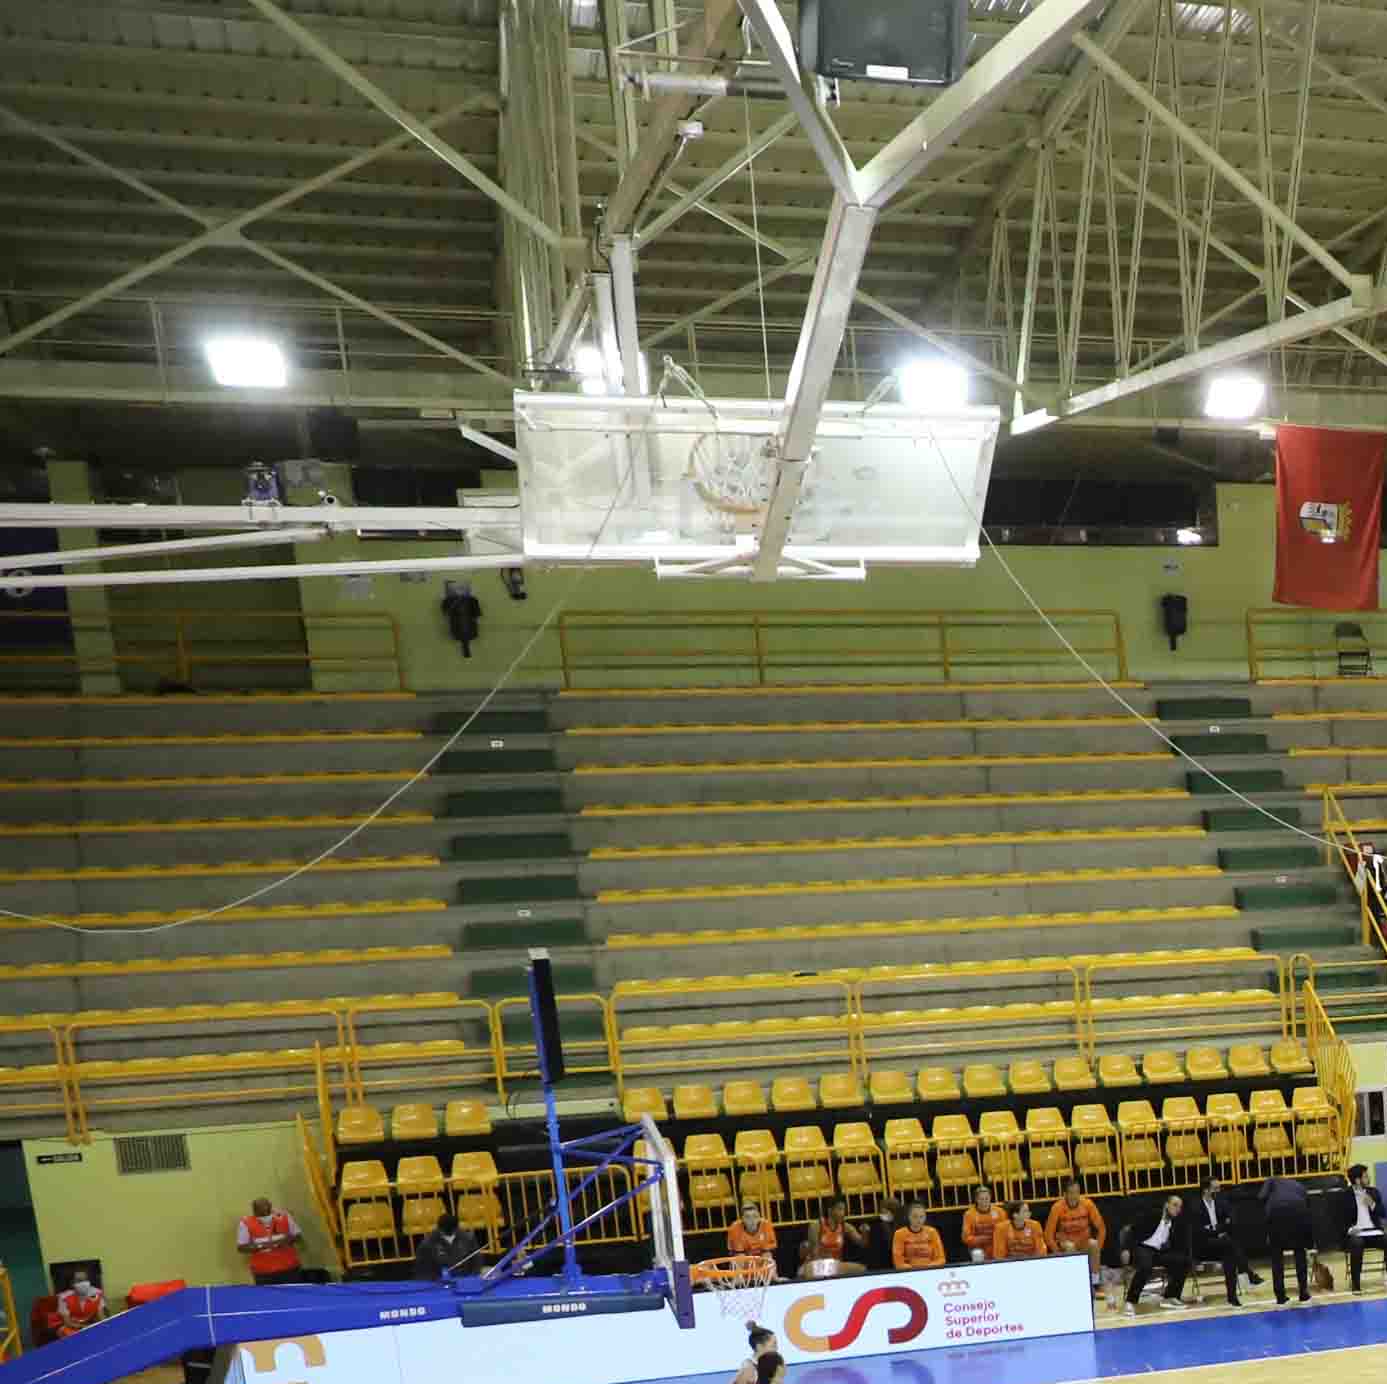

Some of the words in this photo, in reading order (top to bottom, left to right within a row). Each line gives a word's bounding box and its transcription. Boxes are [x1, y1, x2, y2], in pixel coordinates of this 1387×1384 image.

[379, 1305, 427, 1321] MONDO
[541, 1301, 588, 1314] MONDO
[943, 1299, 996, 1315] Consejo
[944, 1312, 1001, 1328] Superior
[946, 1327, 962, 1339] de
[966, 1323, 1025, 1339] Deportes
